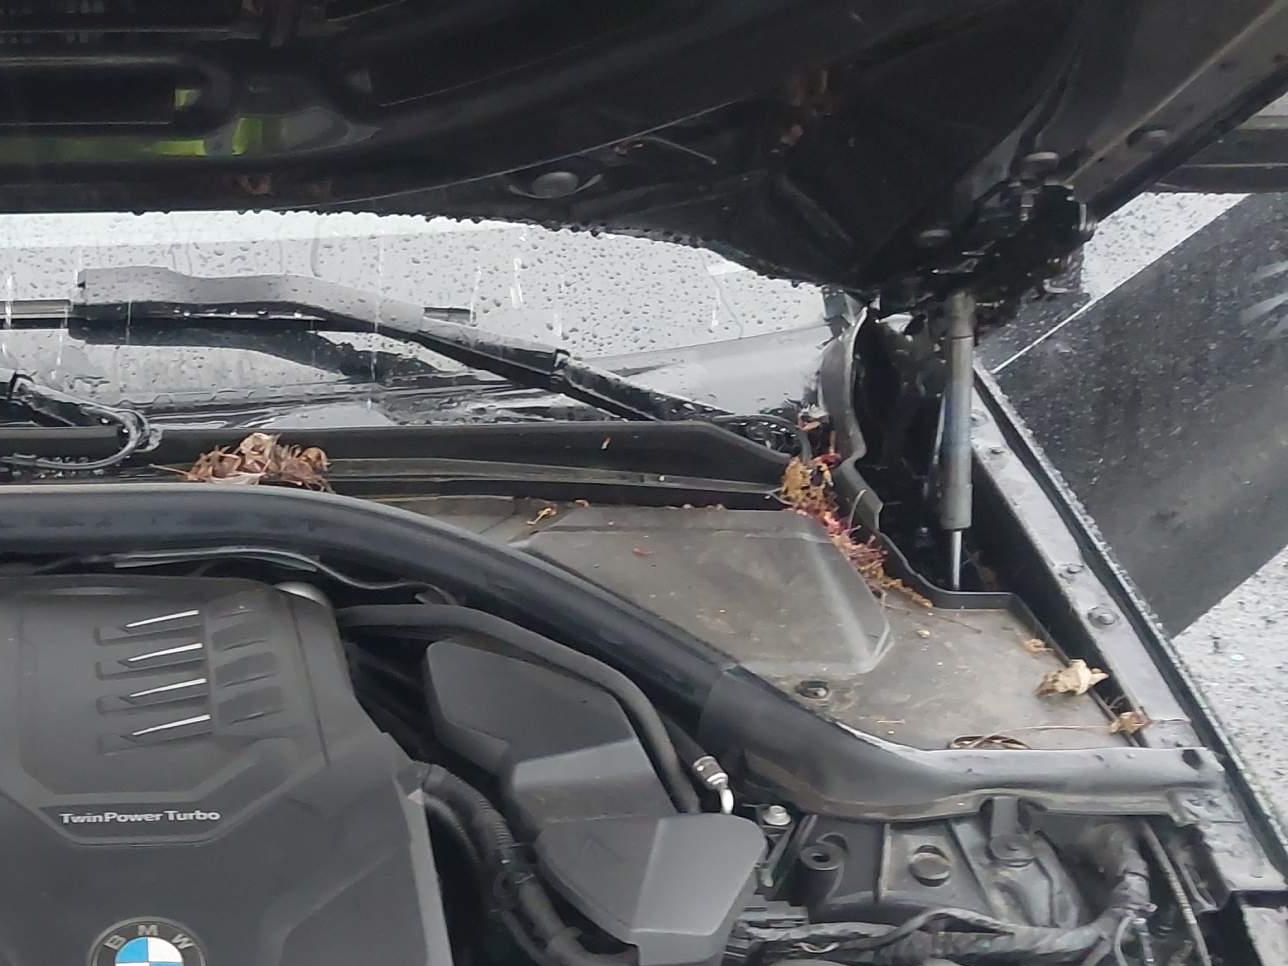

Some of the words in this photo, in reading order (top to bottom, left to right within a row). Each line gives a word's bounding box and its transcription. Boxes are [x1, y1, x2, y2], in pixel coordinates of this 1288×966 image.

[59, 812, 163, 824] TwinPower
[164, 810, 221, 822] Turbo
[105, 924, 195, 950] BMW
